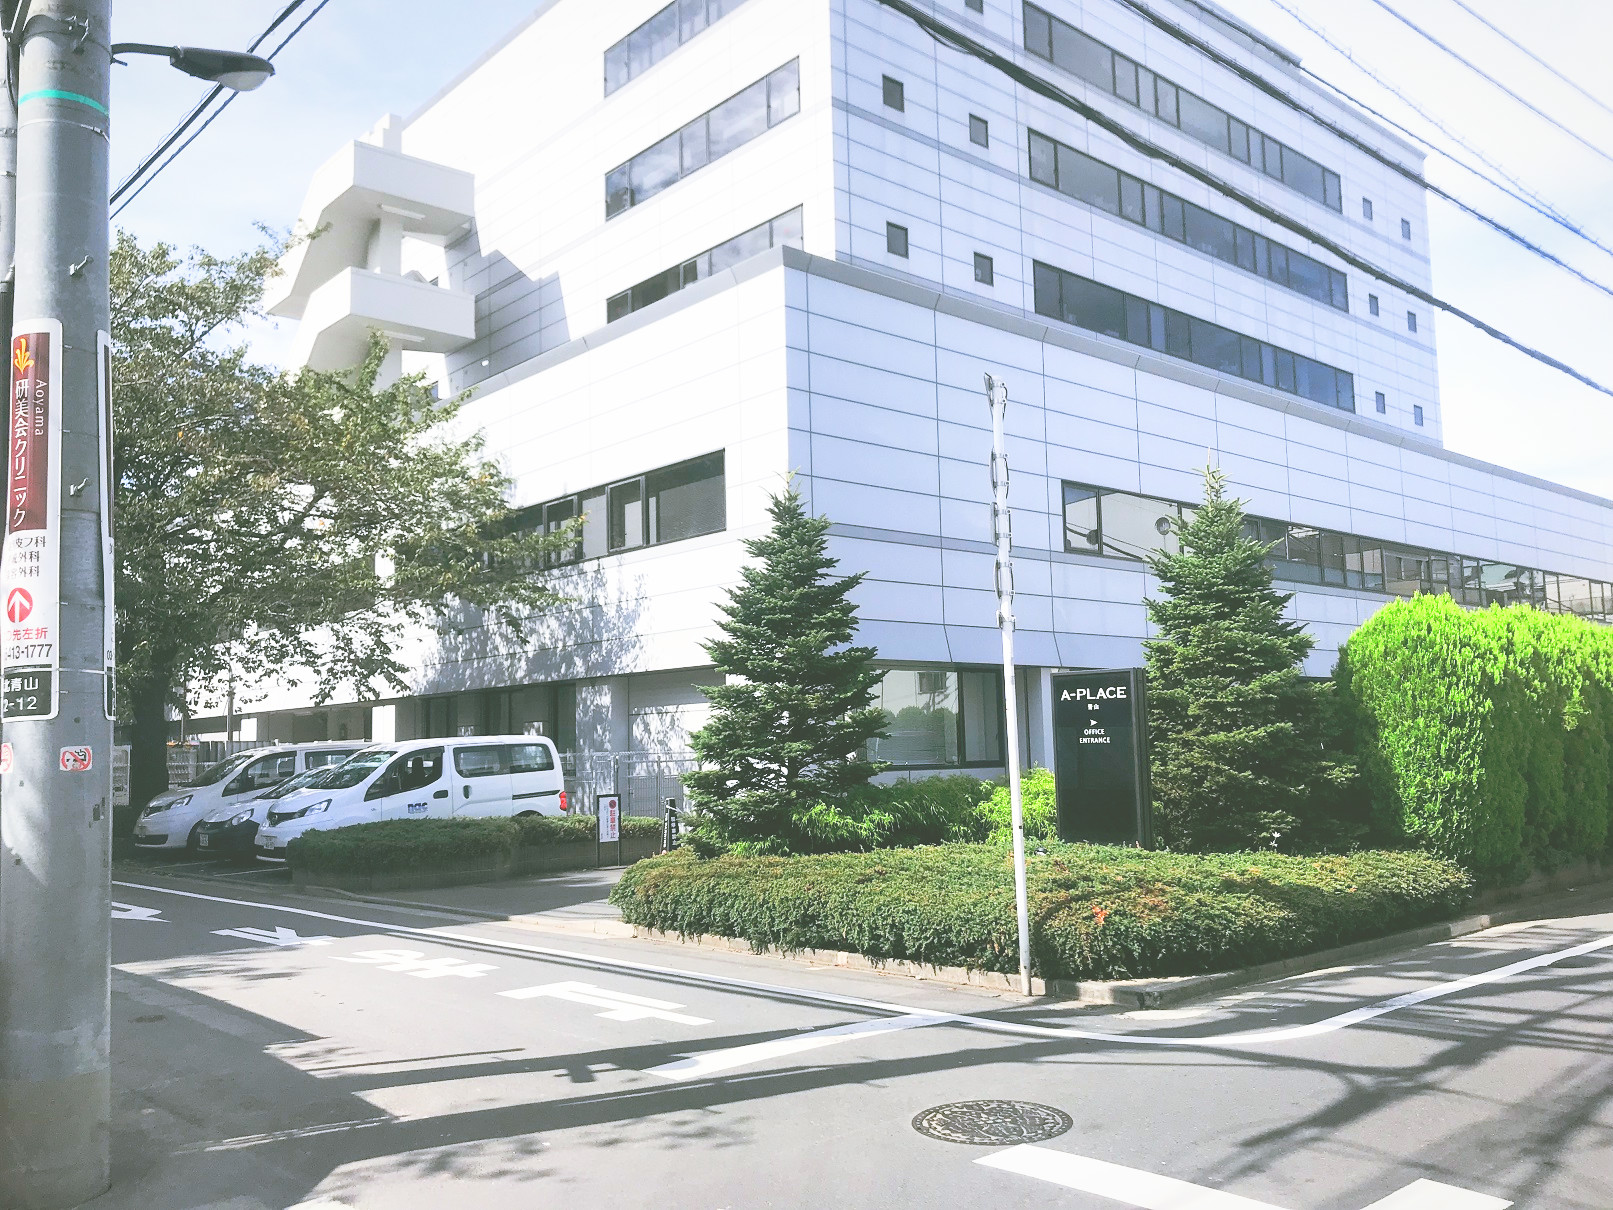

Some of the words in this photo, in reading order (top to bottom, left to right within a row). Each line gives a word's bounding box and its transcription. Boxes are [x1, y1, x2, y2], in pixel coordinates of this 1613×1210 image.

[34, 379, 48, 437] Aoyama
[13, 378, 30, 529] 研美会クリニック
[1060, 686, 1127, 701] A-PLACE
[1083, 728, 1106, 736] OFFICE
[1079, 736, 1112, 744] ENTRANCE
